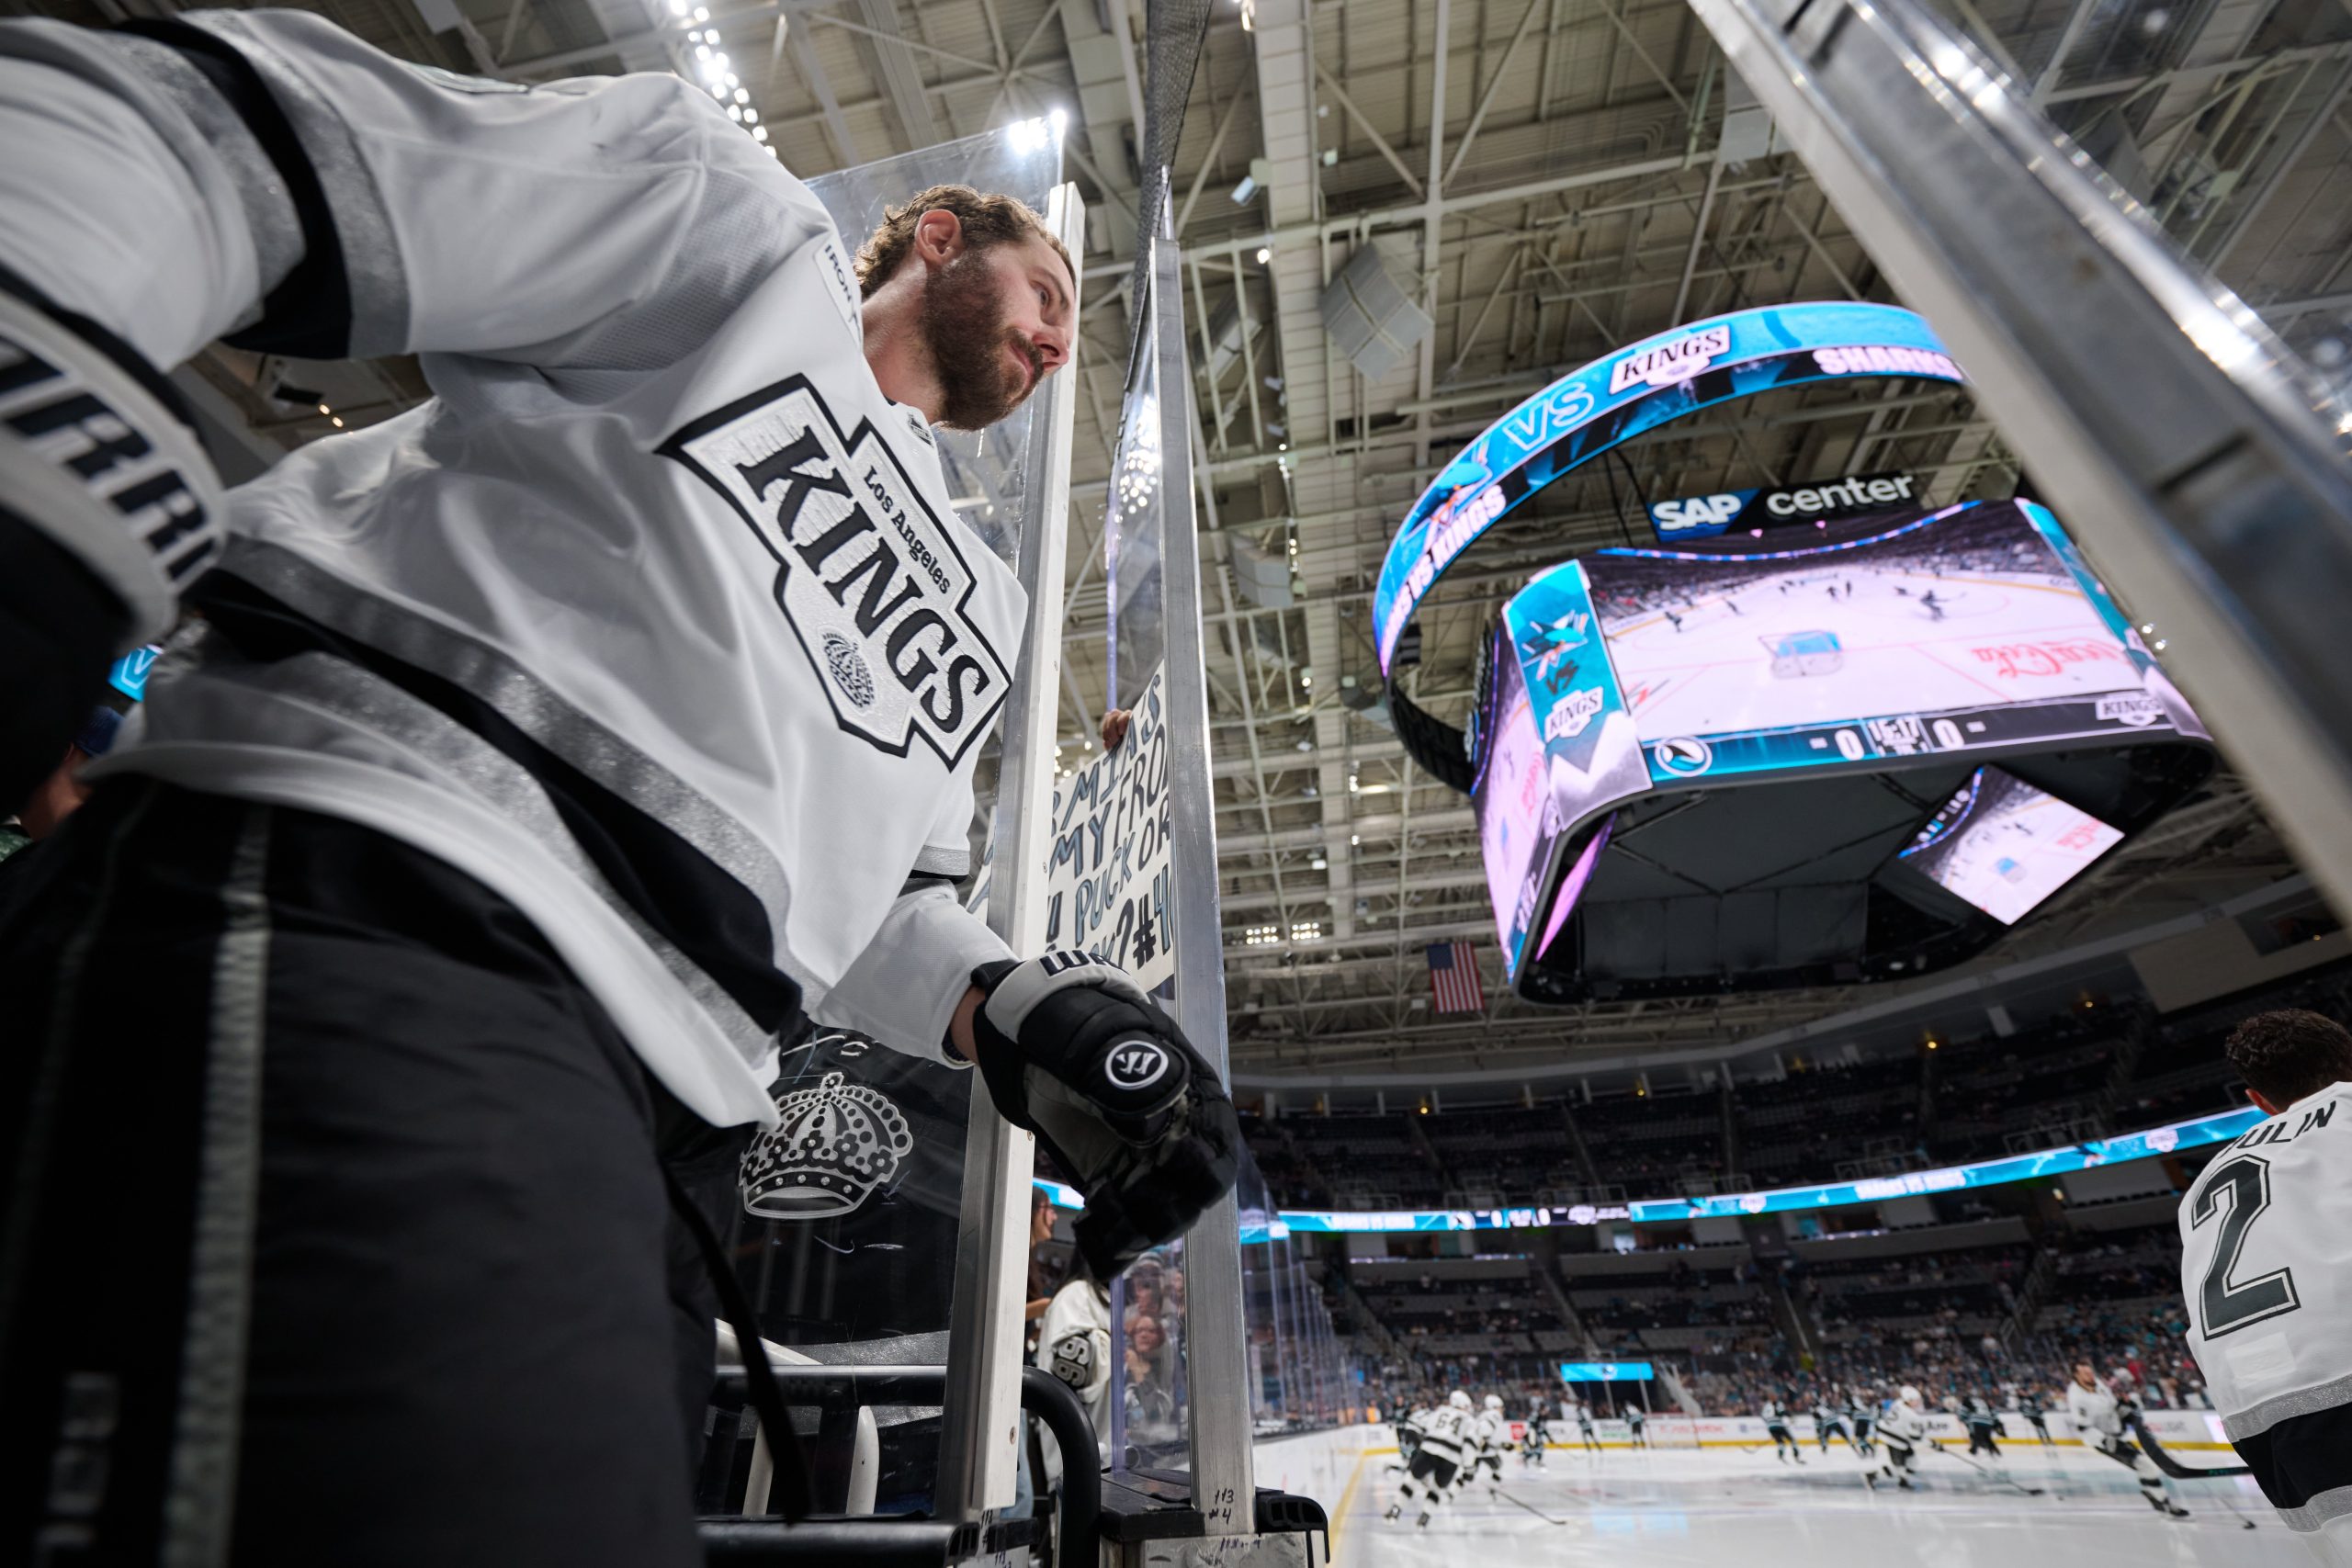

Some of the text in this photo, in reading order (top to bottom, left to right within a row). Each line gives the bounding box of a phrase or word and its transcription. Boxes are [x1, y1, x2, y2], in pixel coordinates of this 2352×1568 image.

[1621, 331, 1722, 382] KINGS
[1502, 381, 1594, 451] VS
[864, 466, 951, 594] Los Angeles
[1430, 484, 1507, 570] KINGS
[1653, 475, 1913, 531] SAP center
[735, 424, 990, 734] KINGS
[1549, 692, 1599, 734] KINGS
[1835, 729, 1864, 761] 0
[1932, 719, 1964, 750] 0
[1113, 723, 1169, 852] FRO
[1075, 831, 1136, 949] PUCK
[2192, 1154, 2301, 1341] 2
[1215, 1488, 1235, 1505] 113
